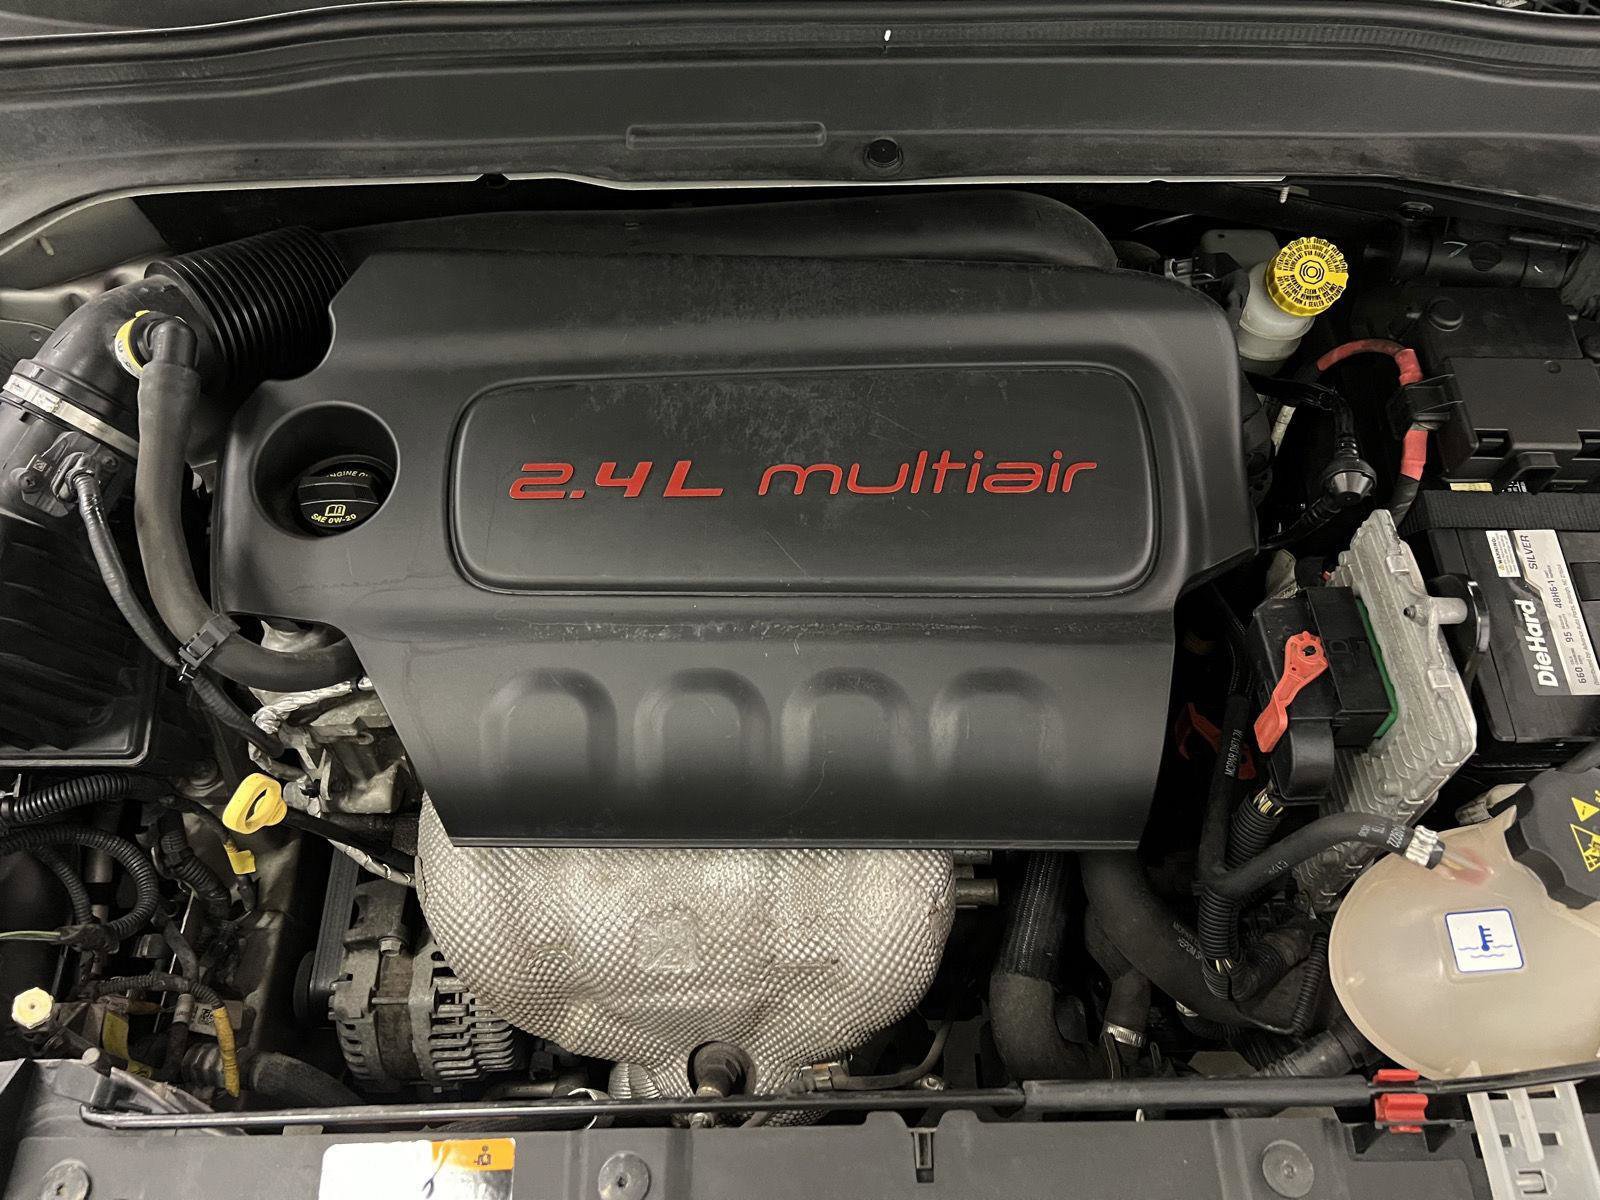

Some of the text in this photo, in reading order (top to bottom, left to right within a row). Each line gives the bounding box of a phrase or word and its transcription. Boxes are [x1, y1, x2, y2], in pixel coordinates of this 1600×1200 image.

[758, 449, 1098, 496] multiair
[310, 513, 327, 524] SAE
[1520, 535, 1537, 569] SILVER
[1514, 599, 1558, 686] DieHard
[1563, 631, 1573, 642] 95
[1575, 667, 1586, 683] 660
